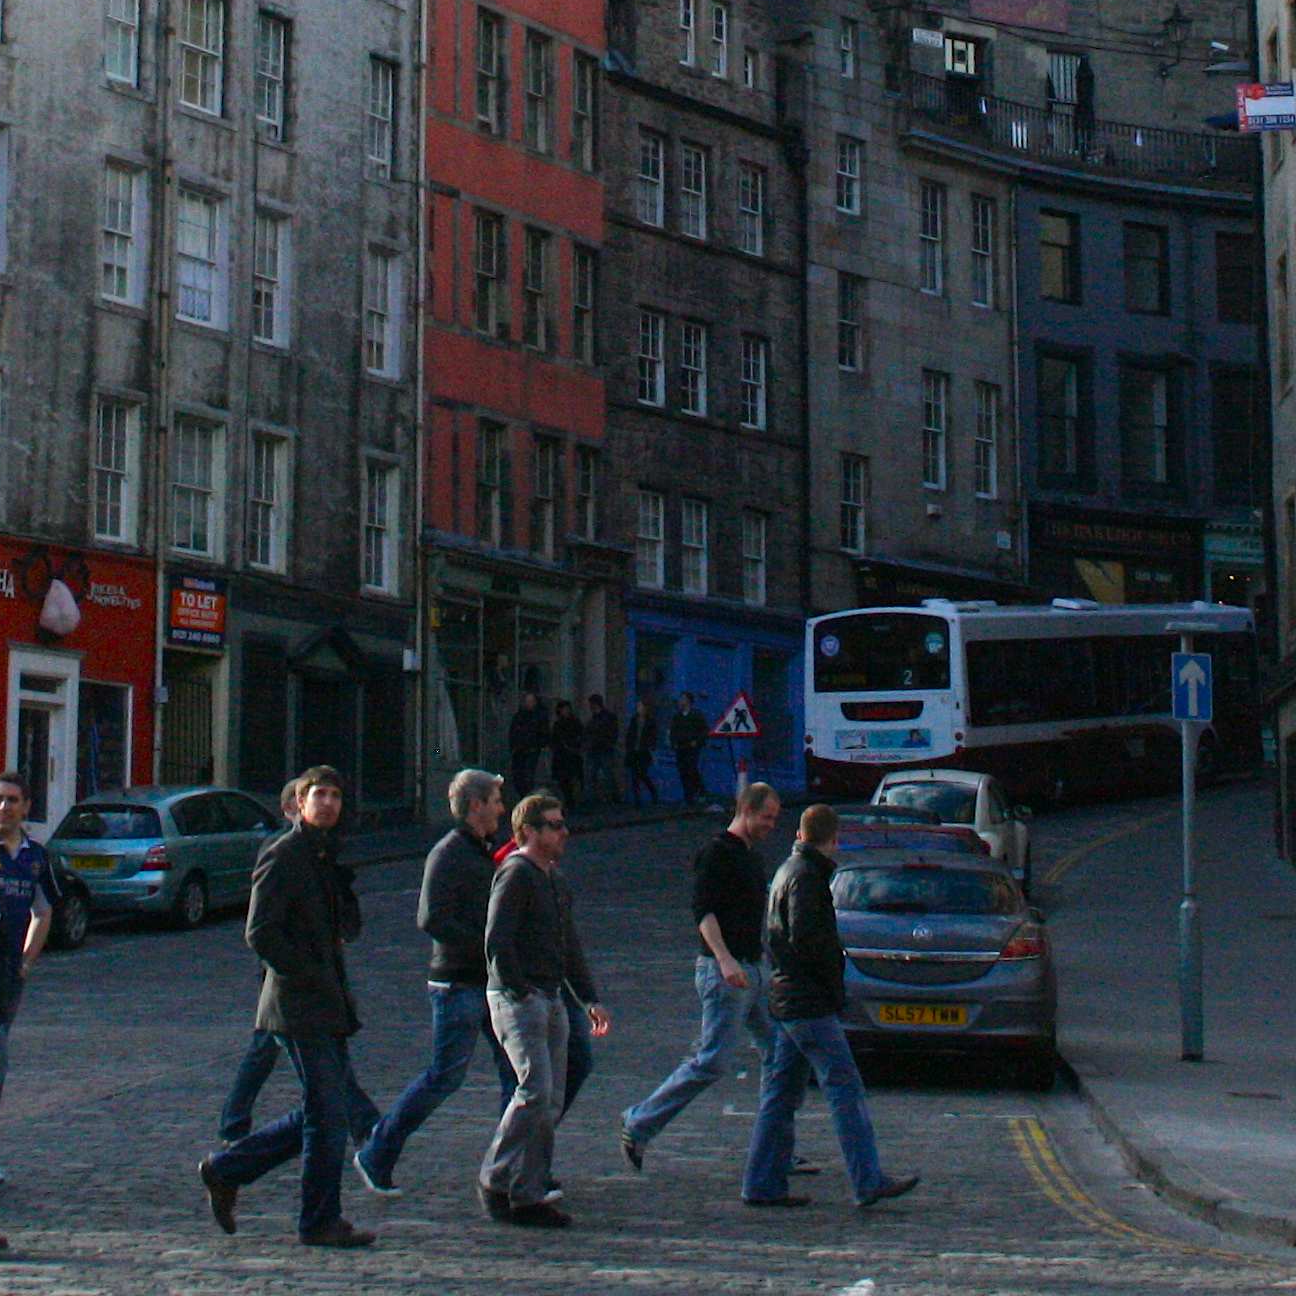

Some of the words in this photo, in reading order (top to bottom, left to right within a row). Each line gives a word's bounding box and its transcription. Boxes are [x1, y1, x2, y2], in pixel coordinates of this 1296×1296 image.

[180, 591, 196, 607] TO
[197, 593, 218, 610] LET
[903, 669, 913, 685] 2
[885, 1006, 926, 1022] SL57
